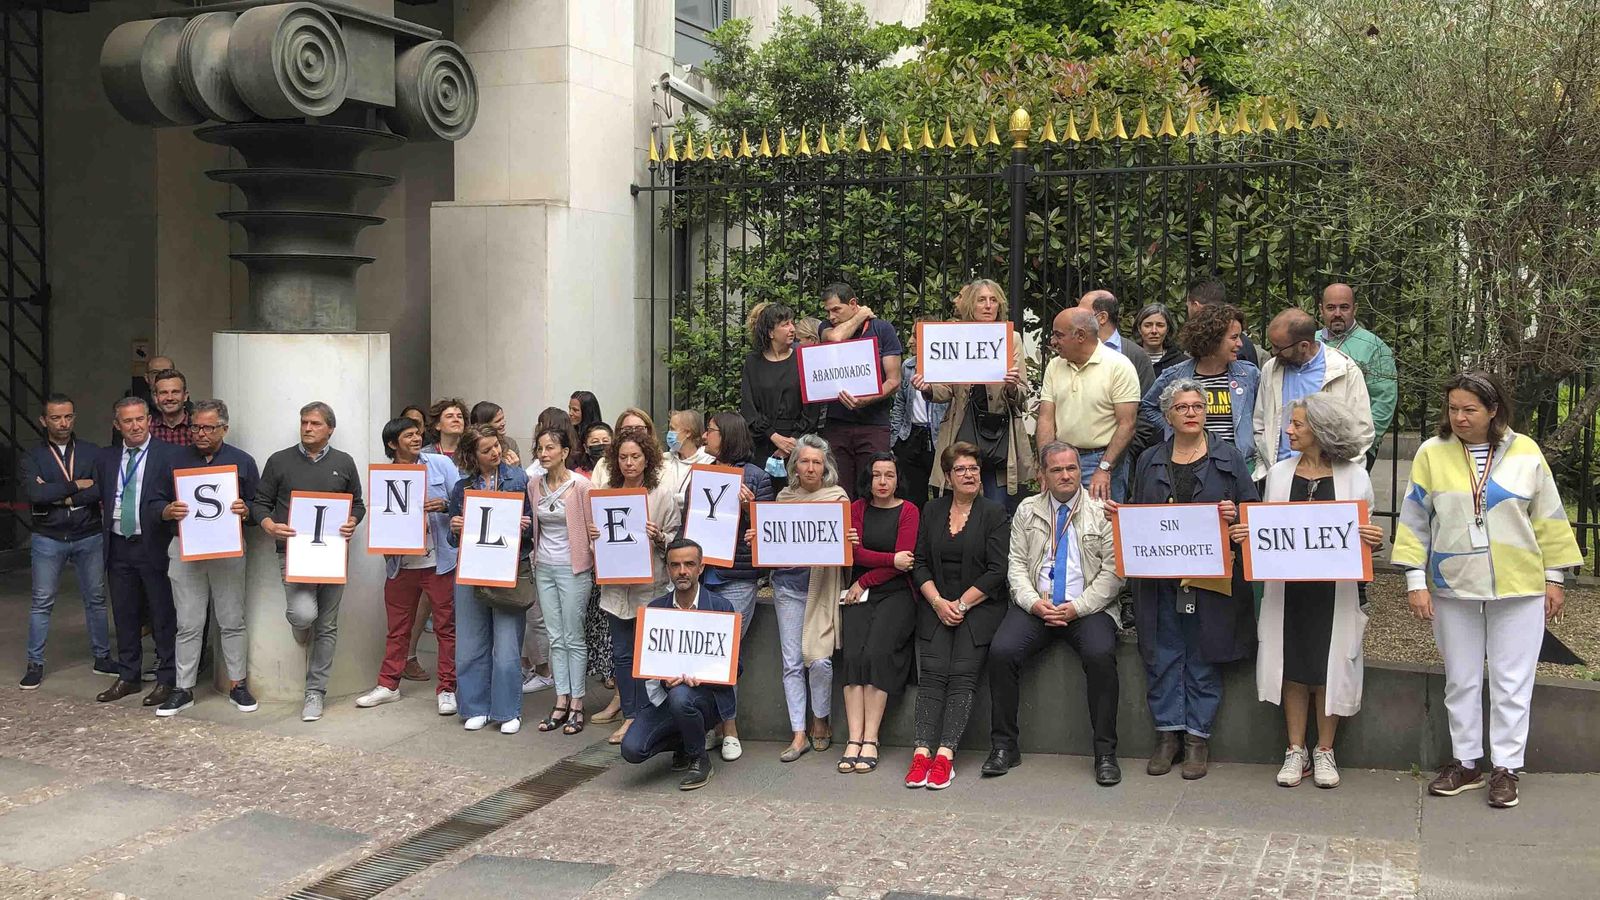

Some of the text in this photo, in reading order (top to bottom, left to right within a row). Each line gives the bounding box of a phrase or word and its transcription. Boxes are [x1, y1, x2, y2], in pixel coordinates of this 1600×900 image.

[929, 337, 1005, 360] SIN LEY
[812, 363, 872, 383] ABANDONADOS
[193, 483, 224, 521] S
[383, 479, 413, 514] N
[702, 483, 731, 520] Y
[311, 505, 329, 546] I
[475, 506, 508, 548] L
[602, 506, 638, 545] E
[763, 520, 840, 543] SIN INDEX
[1160, 519, 1180, 532] SIN
[1257, 520, 1355, 552] SIN LEY
[1132, 543, 1214, 558] TRANSPORTE
[647, 627, 727, 658] SIN INDEX
